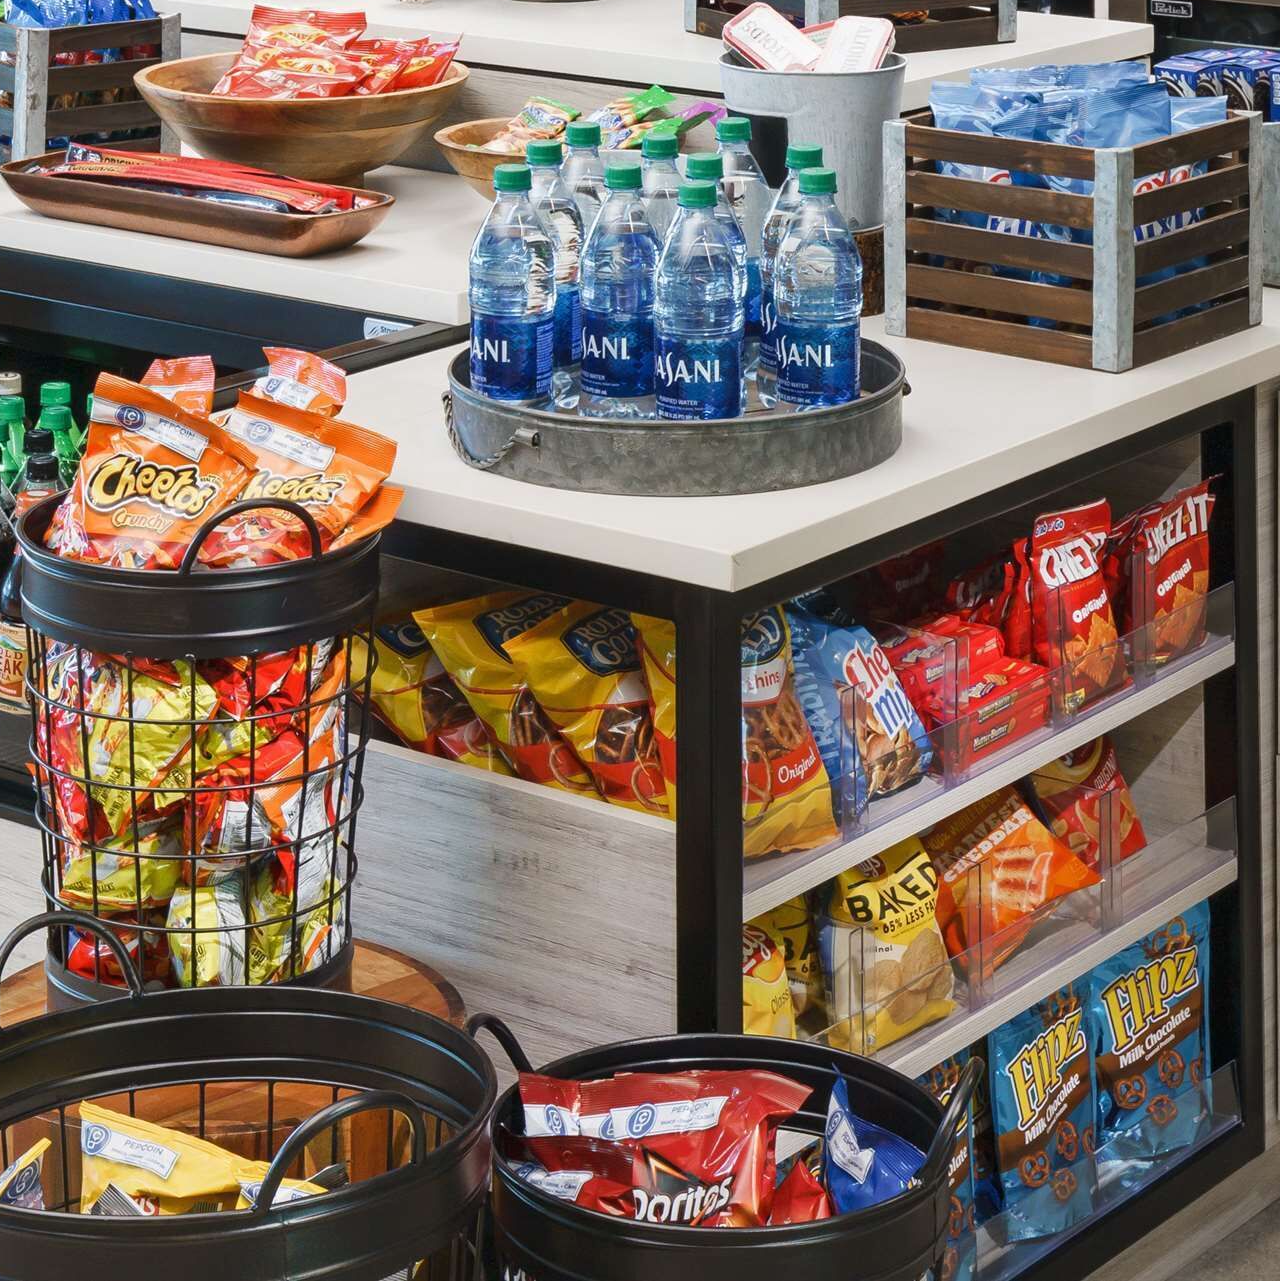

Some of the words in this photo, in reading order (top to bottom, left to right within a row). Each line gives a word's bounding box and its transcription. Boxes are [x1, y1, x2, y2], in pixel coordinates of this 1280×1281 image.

[470, 336, 508, 363] ANI
[581, 326, 628, 360] SANI
[776, 335, 831, 368] ASANI
[656, 351, 720, 387] ASANI
[88, 454, 216, 514] Cheetos
[244, 468, 343, 506] heetos
[111, 509, 176, 532] Crunchy
[778, 748, 816, 784] Original
[933, 793, 1022, 870] HARVEST
[943, 807, 1033, 883] CHEDDAR
[845, 861, 938, 924] BAKED
[882, 919, 902, 935] 65%
[906, 908, 924, 926] LESS
[1103, 948, 1199, 1054] Flipz
[1120, 1047, 1145, 1069] Milk
[1145, 1006, 1191, 1050] Chocolate
[1008, 1009, 1085, 1130] Flipz
[1025, 1117, 1046, 1145] Milk
[1046, 1073, 1081, 1123] Chocolate
[123, 1138, 164, 1156] PEPCOIN
[634, 1175, 734, 1223] Doritos
